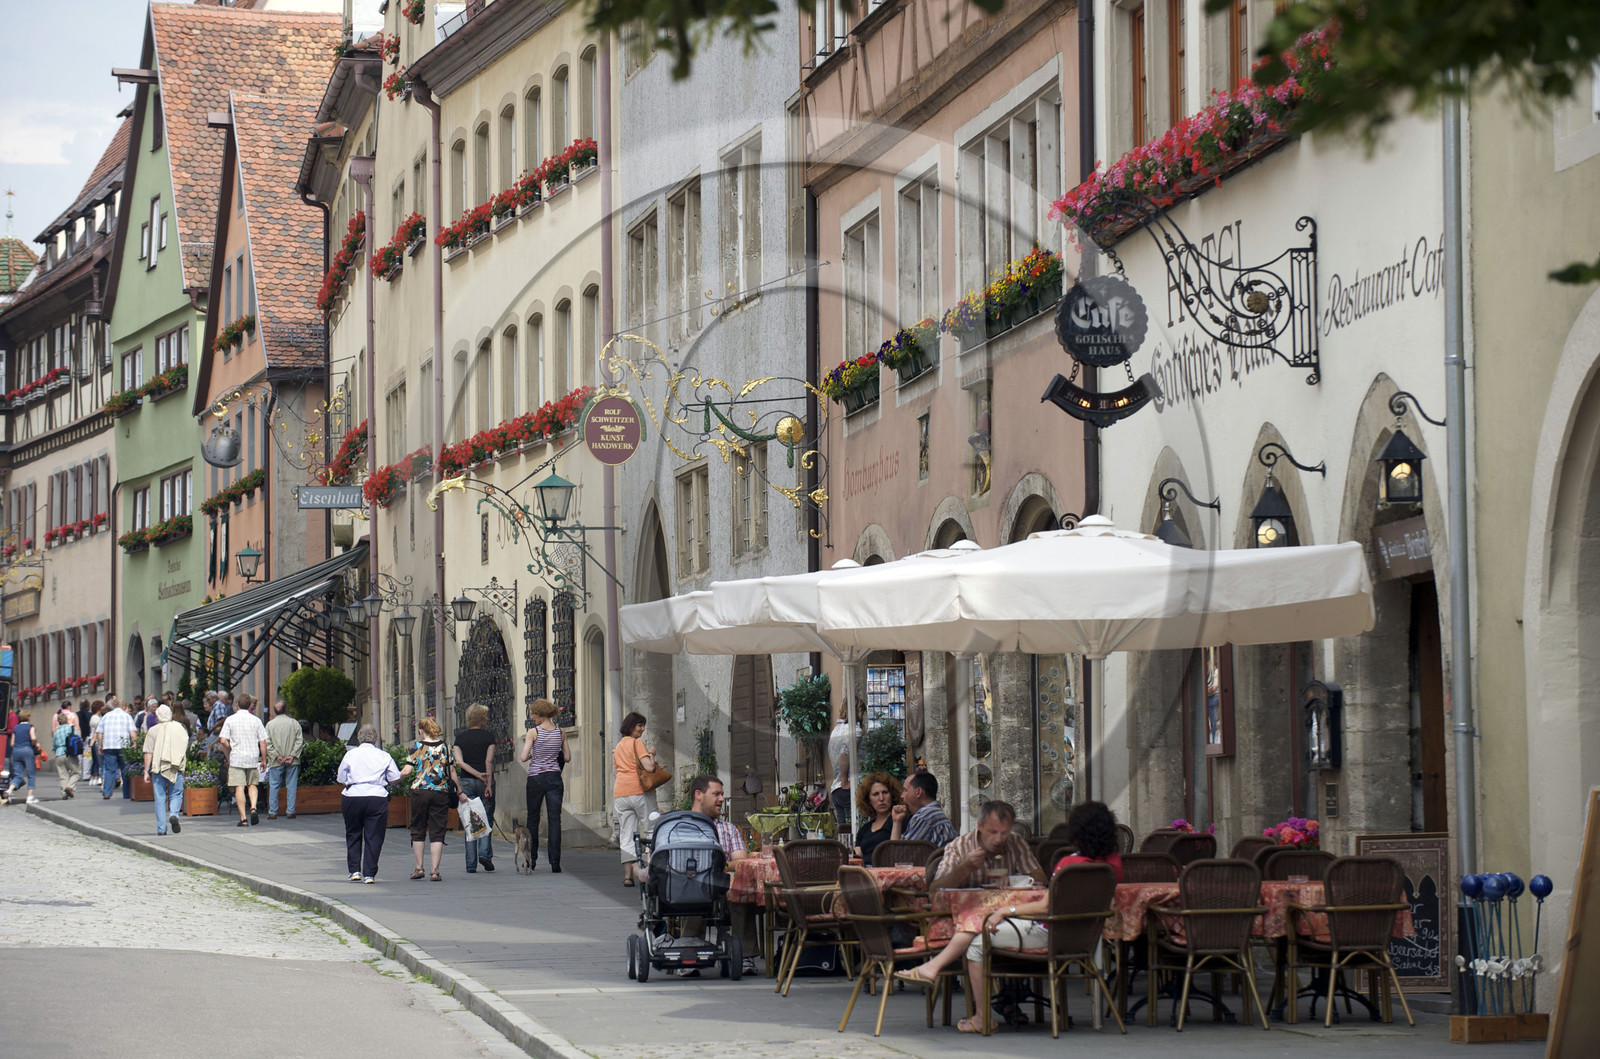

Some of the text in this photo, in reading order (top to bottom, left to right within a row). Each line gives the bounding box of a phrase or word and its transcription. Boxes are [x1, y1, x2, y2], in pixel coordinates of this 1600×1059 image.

[1167, 219, 1243, 329] HOTEL
[1323, 232, 1446, 337] Restaurant-Caf
[1071, 296, 1136, 334] Café
[1088, 345, 1121, 355] HAUS
[592, 442, 634, 450] HANDWERK
[300, 490, 360, 505] Eisenhut
